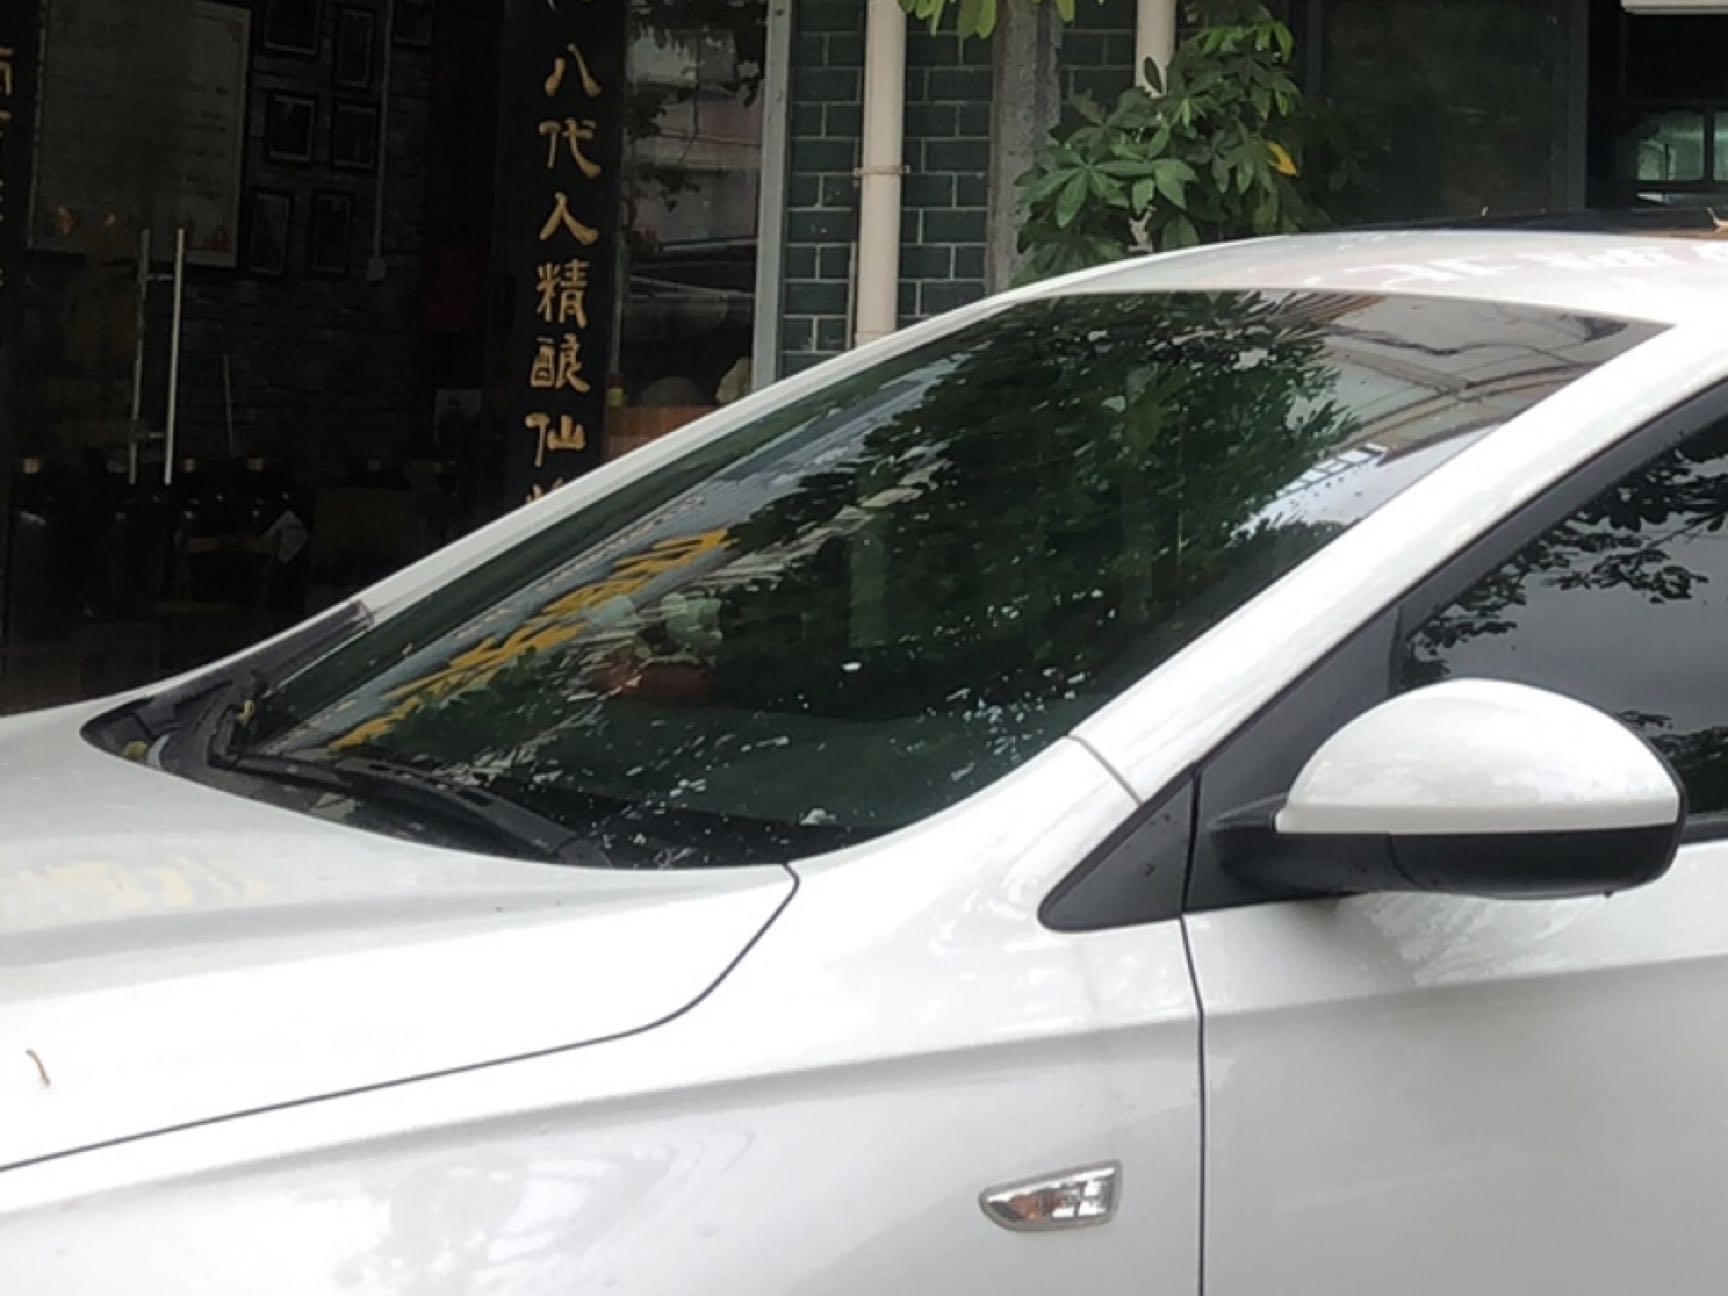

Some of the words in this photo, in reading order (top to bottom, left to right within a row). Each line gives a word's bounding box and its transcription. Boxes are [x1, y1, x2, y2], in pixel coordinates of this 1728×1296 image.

[524, 42, 602, 504] 八代人精酿仙
